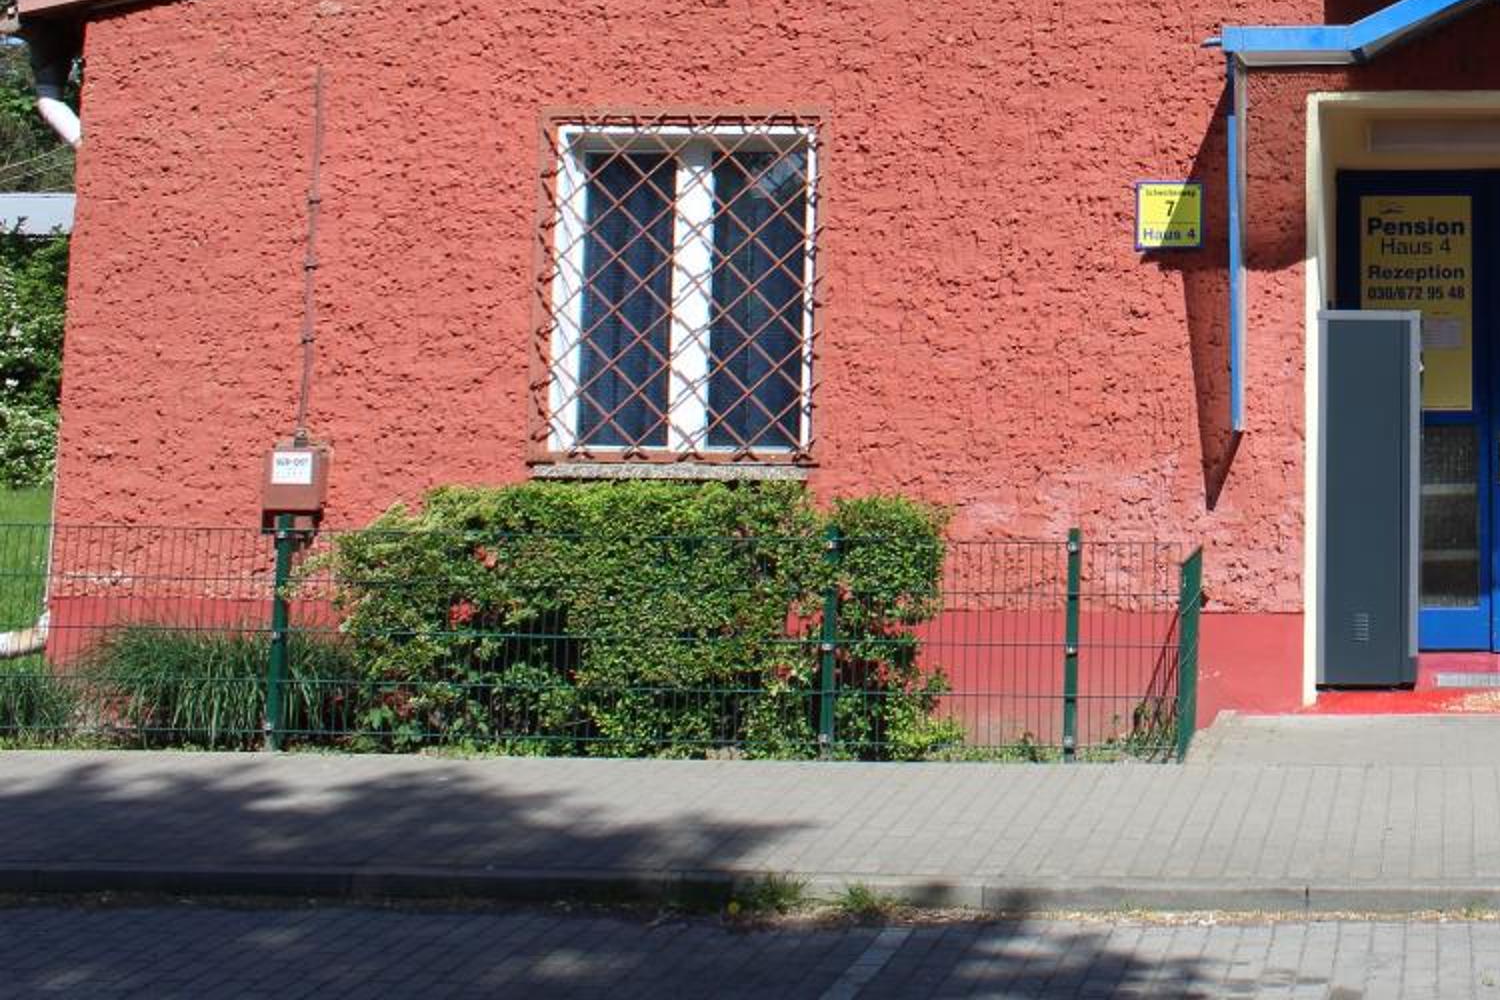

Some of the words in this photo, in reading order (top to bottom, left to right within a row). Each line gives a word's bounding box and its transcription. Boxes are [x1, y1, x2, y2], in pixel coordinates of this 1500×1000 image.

[1165, 200, 1175, 216] 7
[1367, 217, 1465, 235] Pension
[1381, 238, 1433, 255] Haus
[1439, 238, 1452, 252] 4
[1367, 265, 1465, 282] Rezeption
